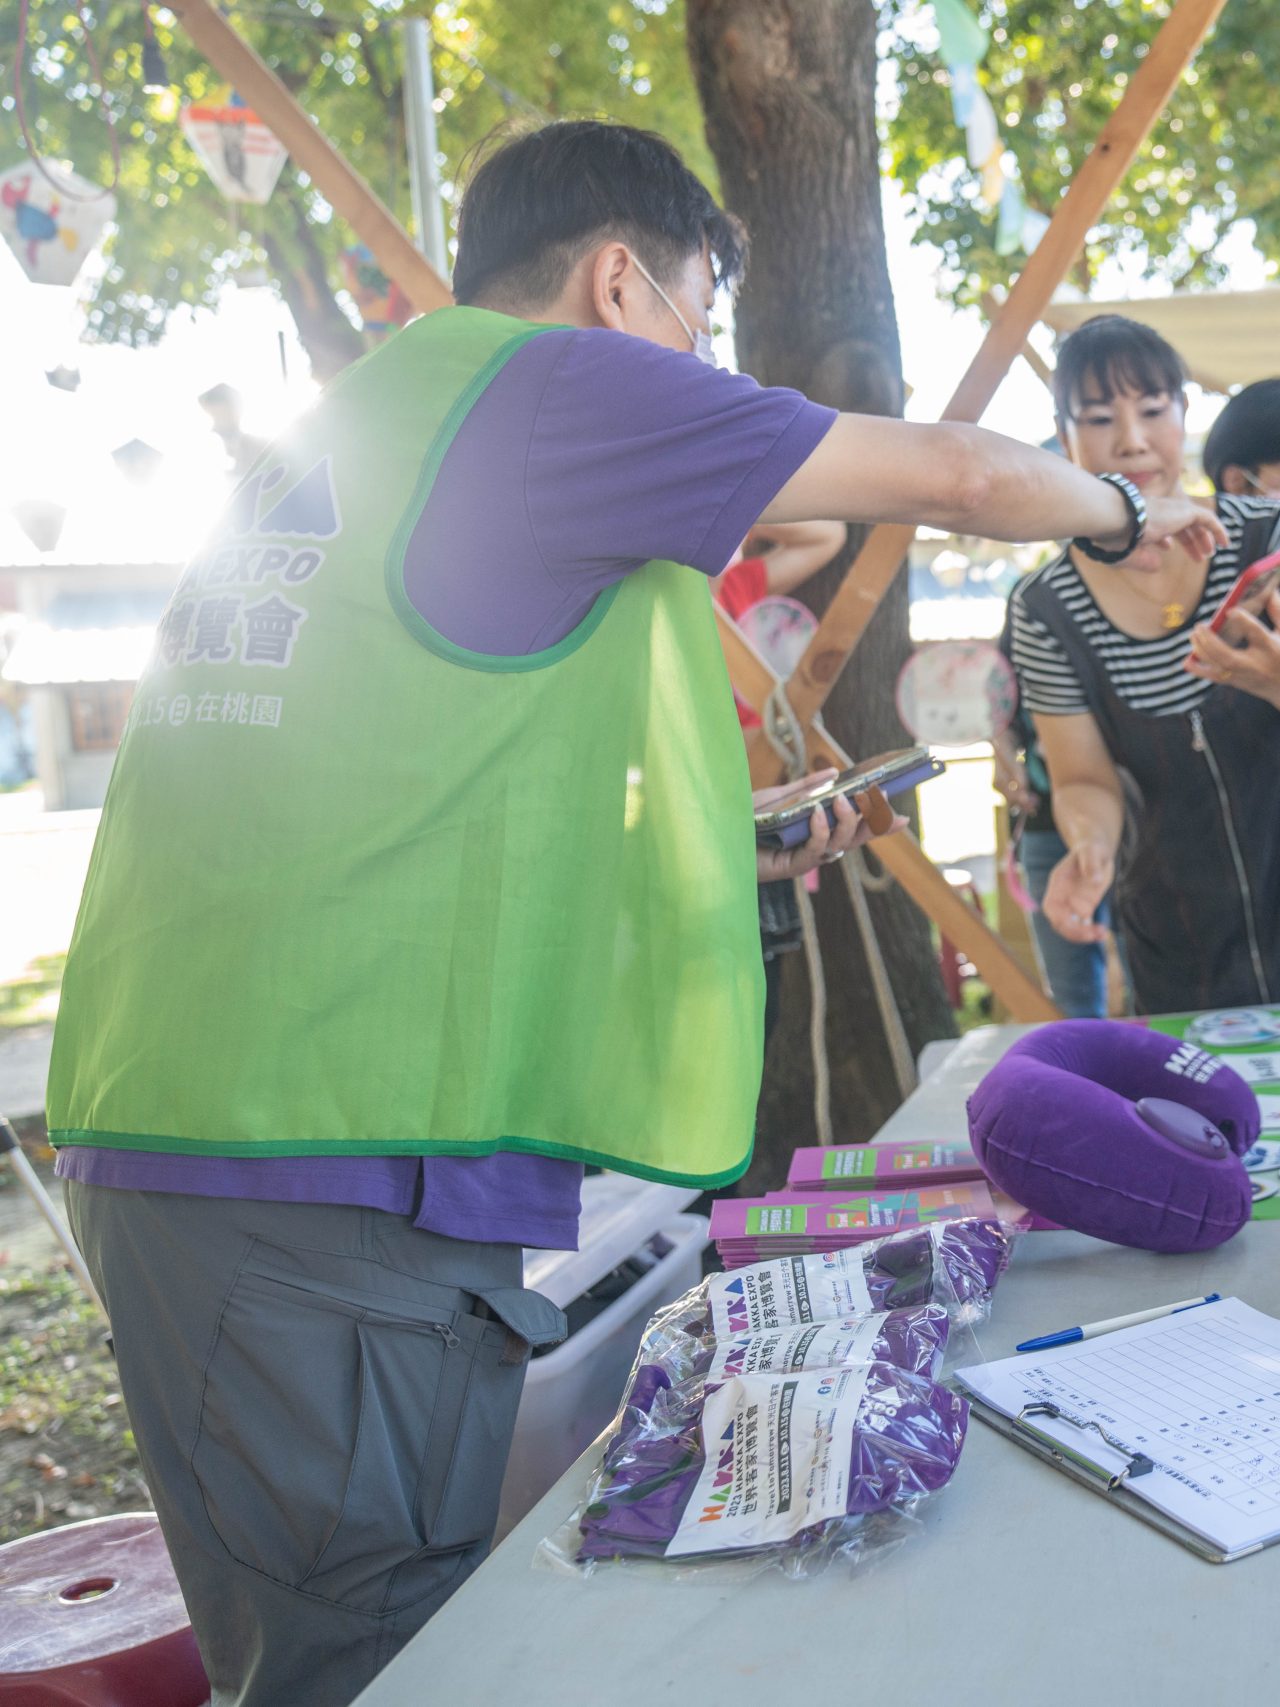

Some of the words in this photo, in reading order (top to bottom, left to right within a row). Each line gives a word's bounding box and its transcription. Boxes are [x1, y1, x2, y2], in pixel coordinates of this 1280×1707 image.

[740, 1404, 759, 1516] 世界客家博覽會
[726, 1494, 743, 1518] 2023
